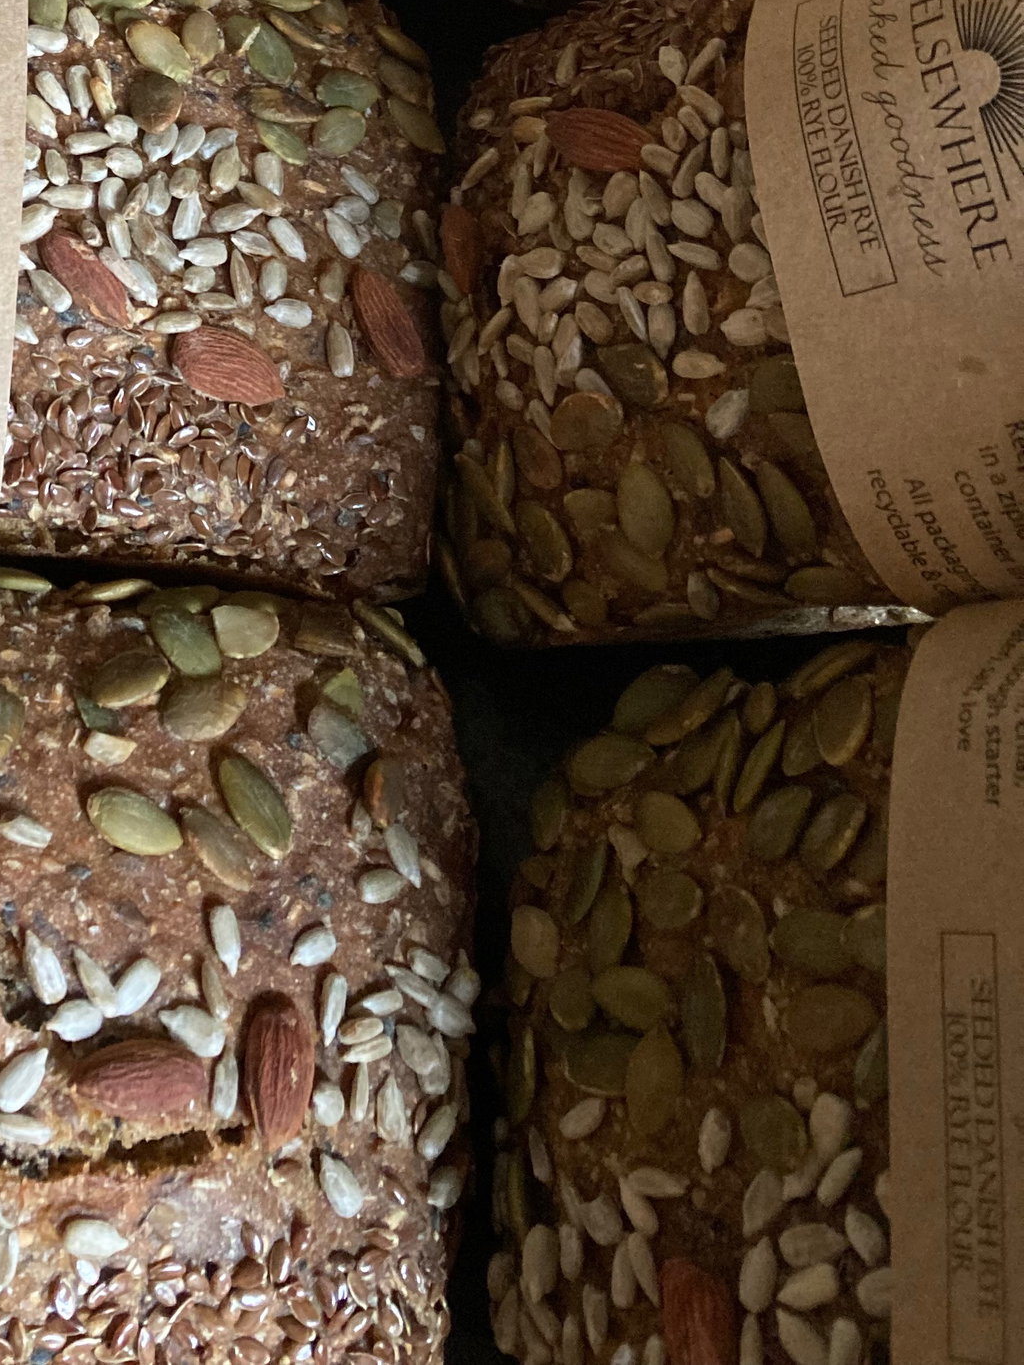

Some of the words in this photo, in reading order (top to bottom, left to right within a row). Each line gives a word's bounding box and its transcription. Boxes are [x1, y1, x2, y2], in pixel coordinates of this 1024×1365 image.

[796, 43, 818, 98] 100%
[819, 14, 844, 100] SEEDED
[802, 97, 827, 145] RYE
[828, 104, 866, 202] DANISH
[811, 145, 848, 234] FLOUR
[861, 90, 947, 278] goodness
[852, 201, 882, 255] RYE
[903, 477, 933, 506] All
[979, 445, 1000, 467] in
[990, 472, 1007, 486] a
[867, 468, 927, 567] recyclable
[954, 470, 1016, 564] container
[957, 701, 977, 753] love
[985, 724, 1001, 807] starter
